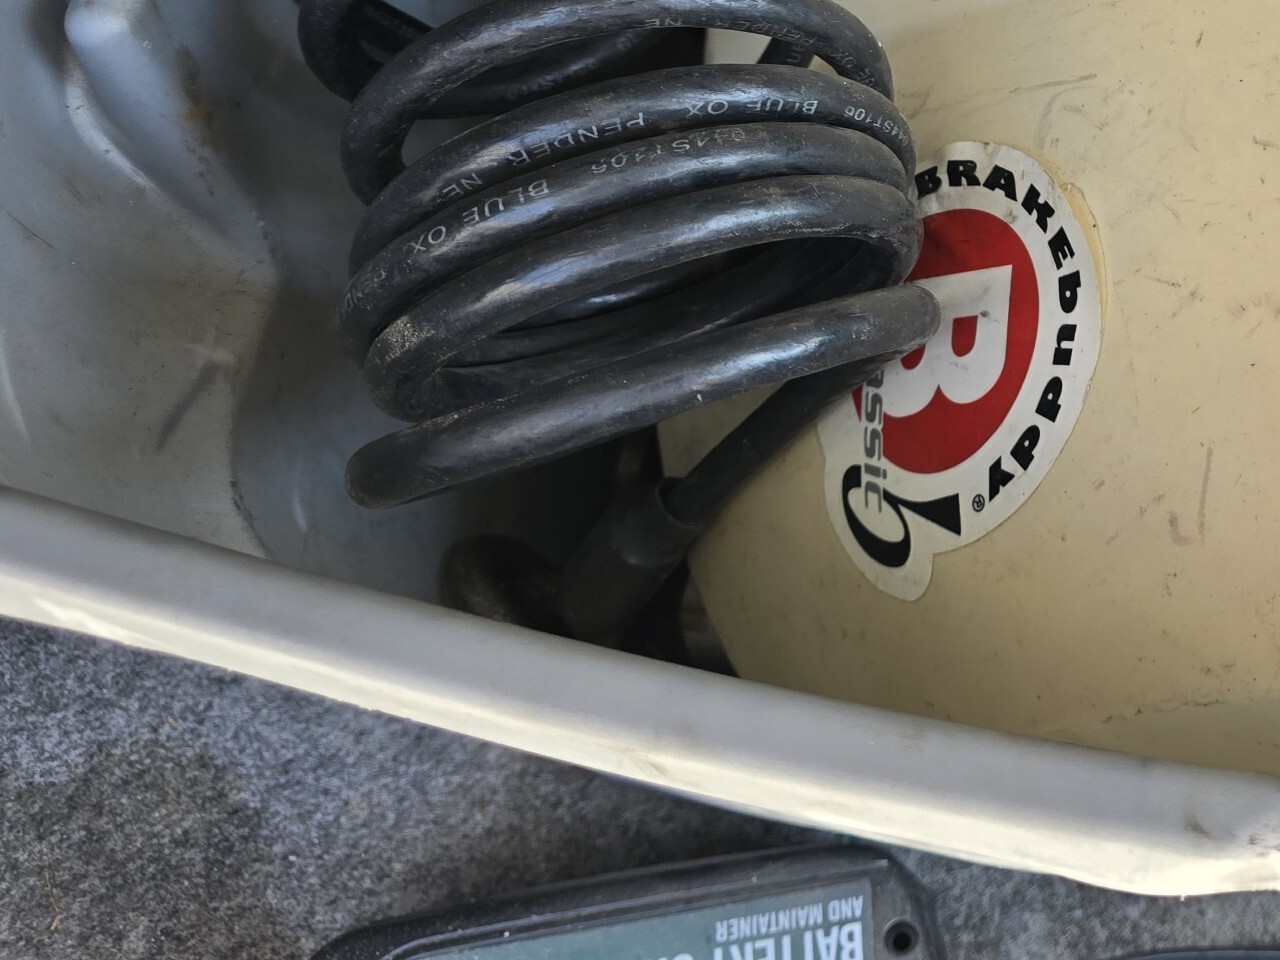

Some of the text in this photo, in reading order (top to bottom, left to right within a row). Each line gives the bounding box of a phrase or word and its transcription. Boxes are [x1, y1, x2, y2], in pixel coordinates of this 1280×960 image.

[685, 99, 729, 117] OX
[507, 112, 646, 168] PENDER
[442, 172, 484, 199] NE
[462, 178, 550, 224] BLUE
[409, 225, 447, 256] OX
[714, 894, 863, 943] AND MAINTAINER
